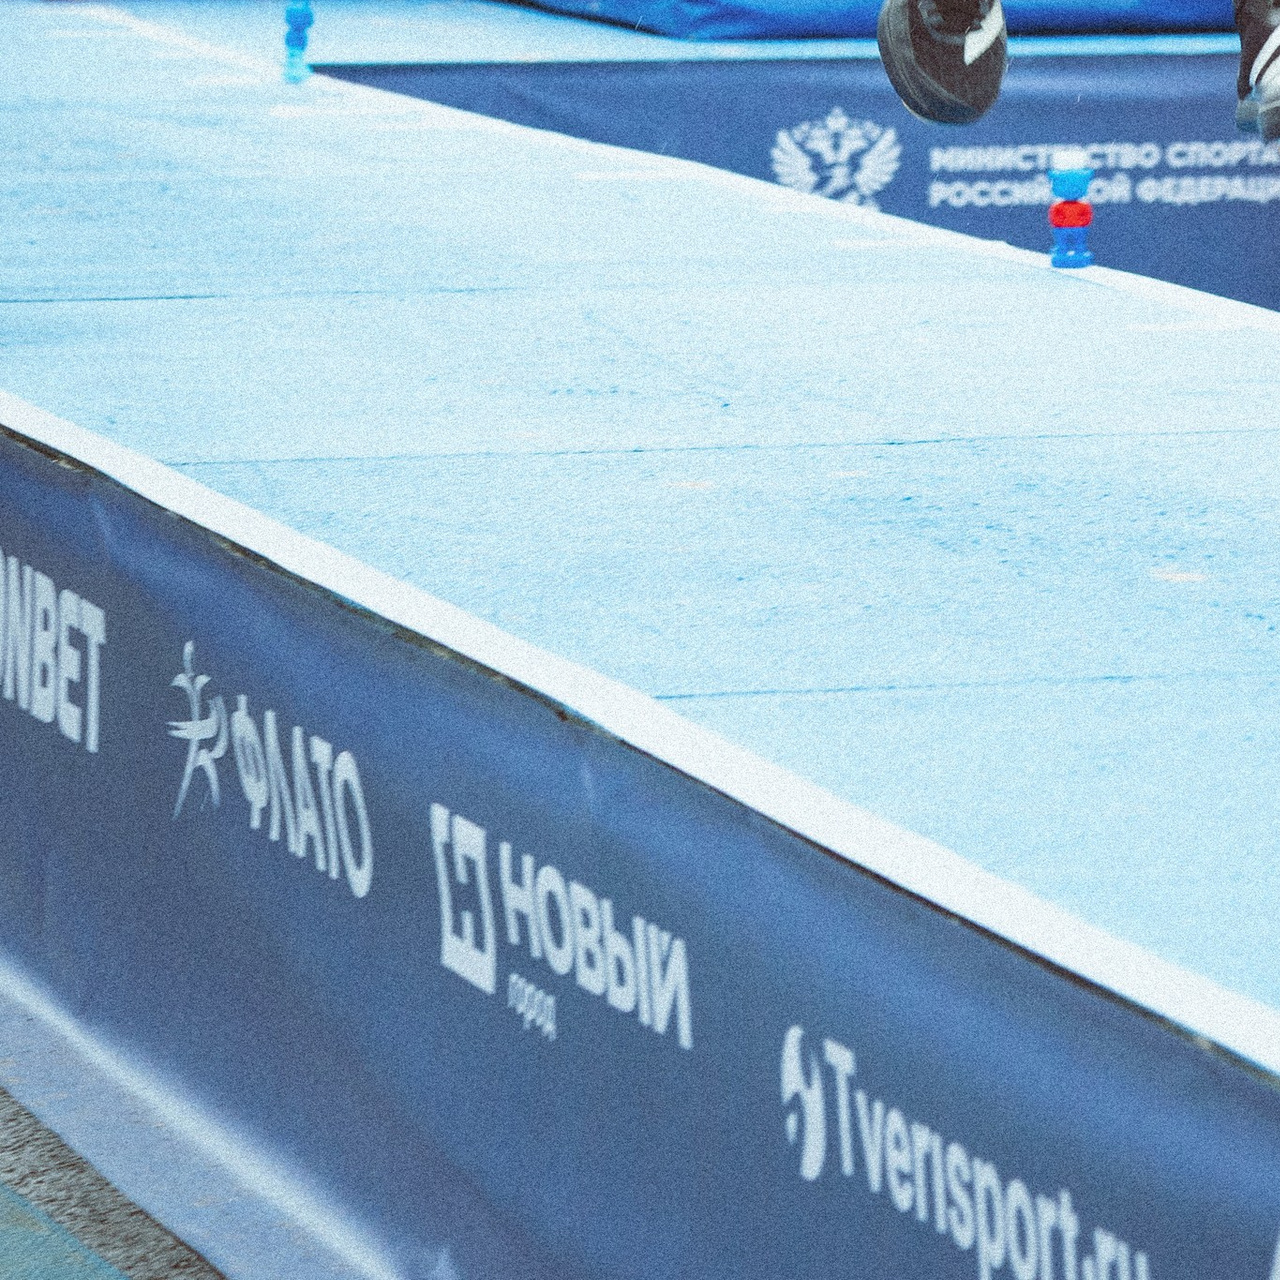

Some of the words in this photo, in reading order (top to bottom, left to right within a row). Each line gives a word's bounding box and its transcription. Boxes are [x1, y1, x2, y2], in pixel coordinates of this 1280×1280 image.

[930, 143, 1161, 173] МИНИСТСТВО
[0, 550, 106, 754] NBET
[499, 841, 693, 1051] НОВЫЙ
